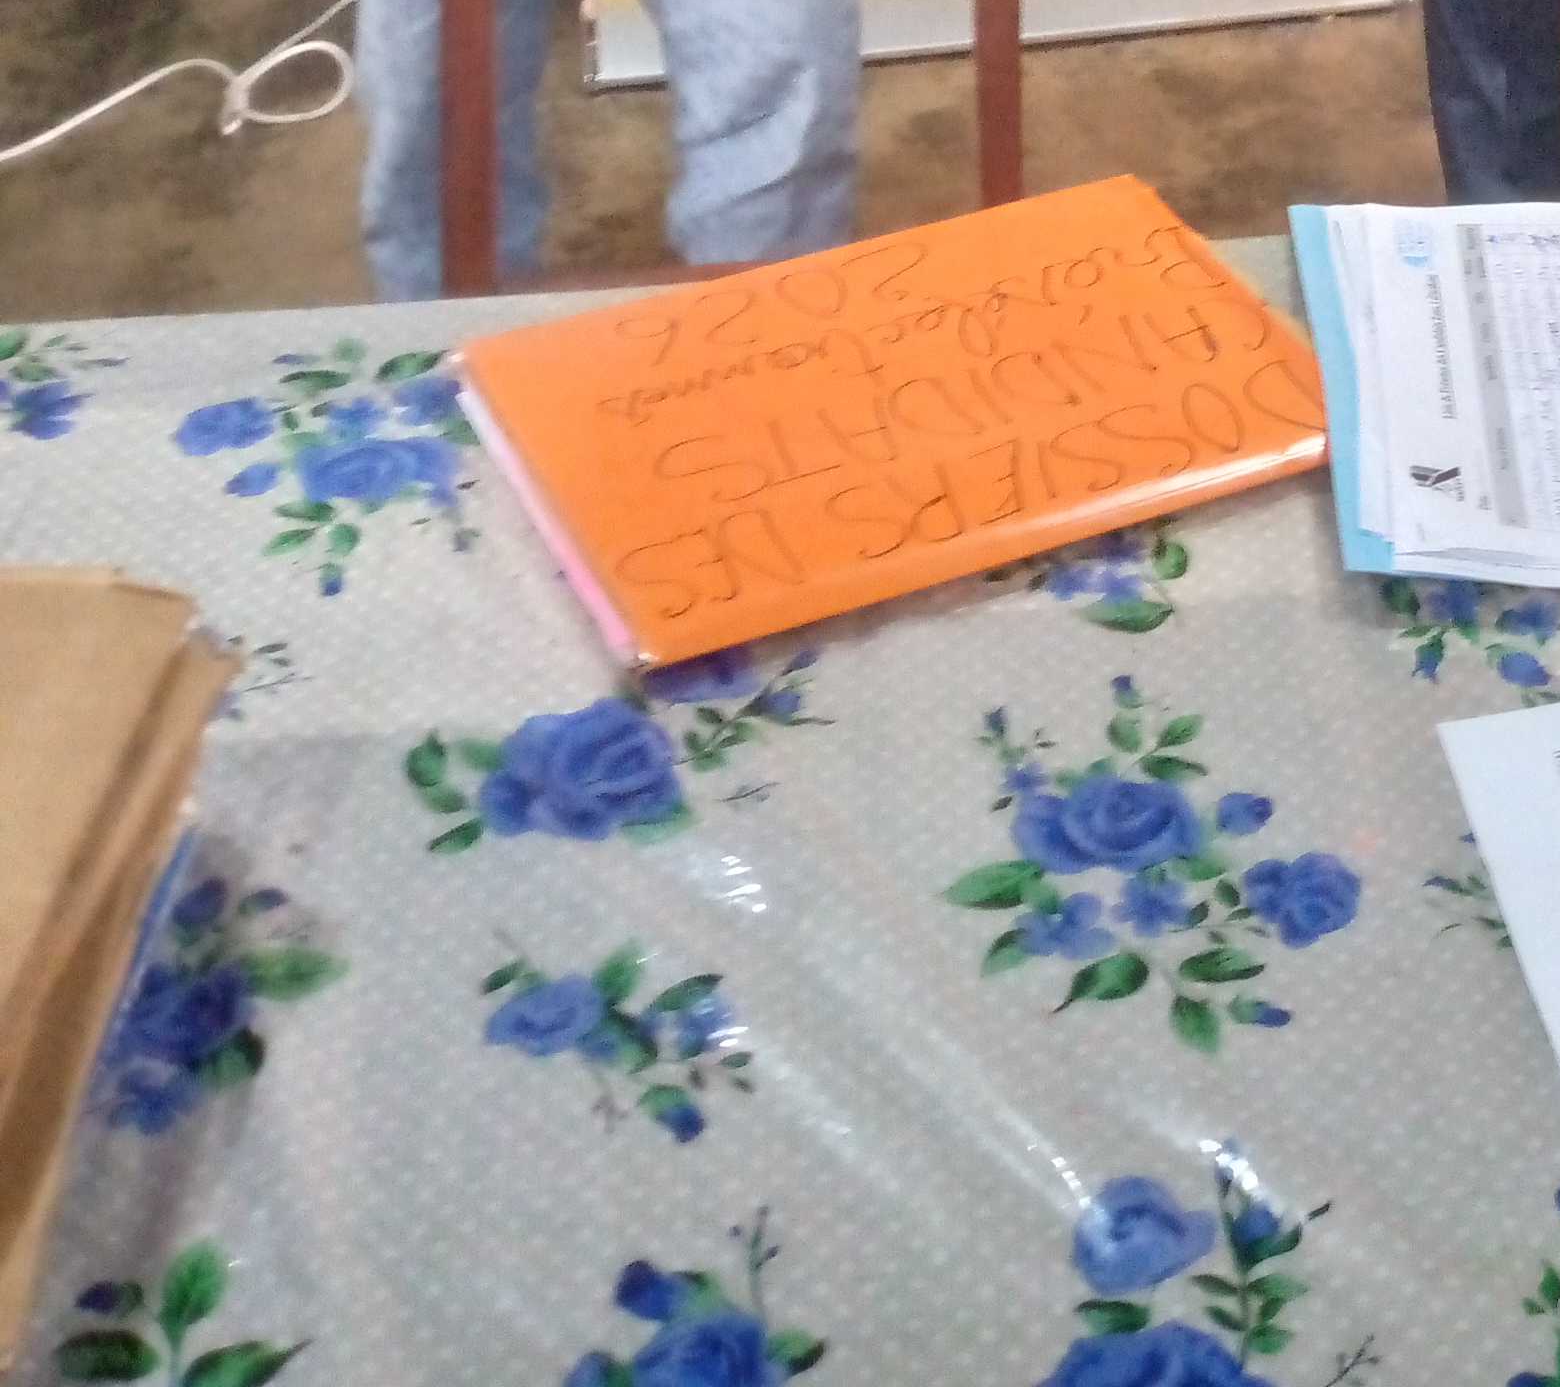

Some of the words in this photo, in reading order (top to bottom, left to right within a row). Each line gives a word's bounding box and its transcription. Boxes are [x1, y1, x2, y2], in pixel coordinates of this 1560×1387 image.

[614, 241, 929, 367] 2026
[654, 298, 1274, 502] CANDIDATS
[825, 358, 1326, 561] DOSSIERS
[614, 514, 804, 619] DES
